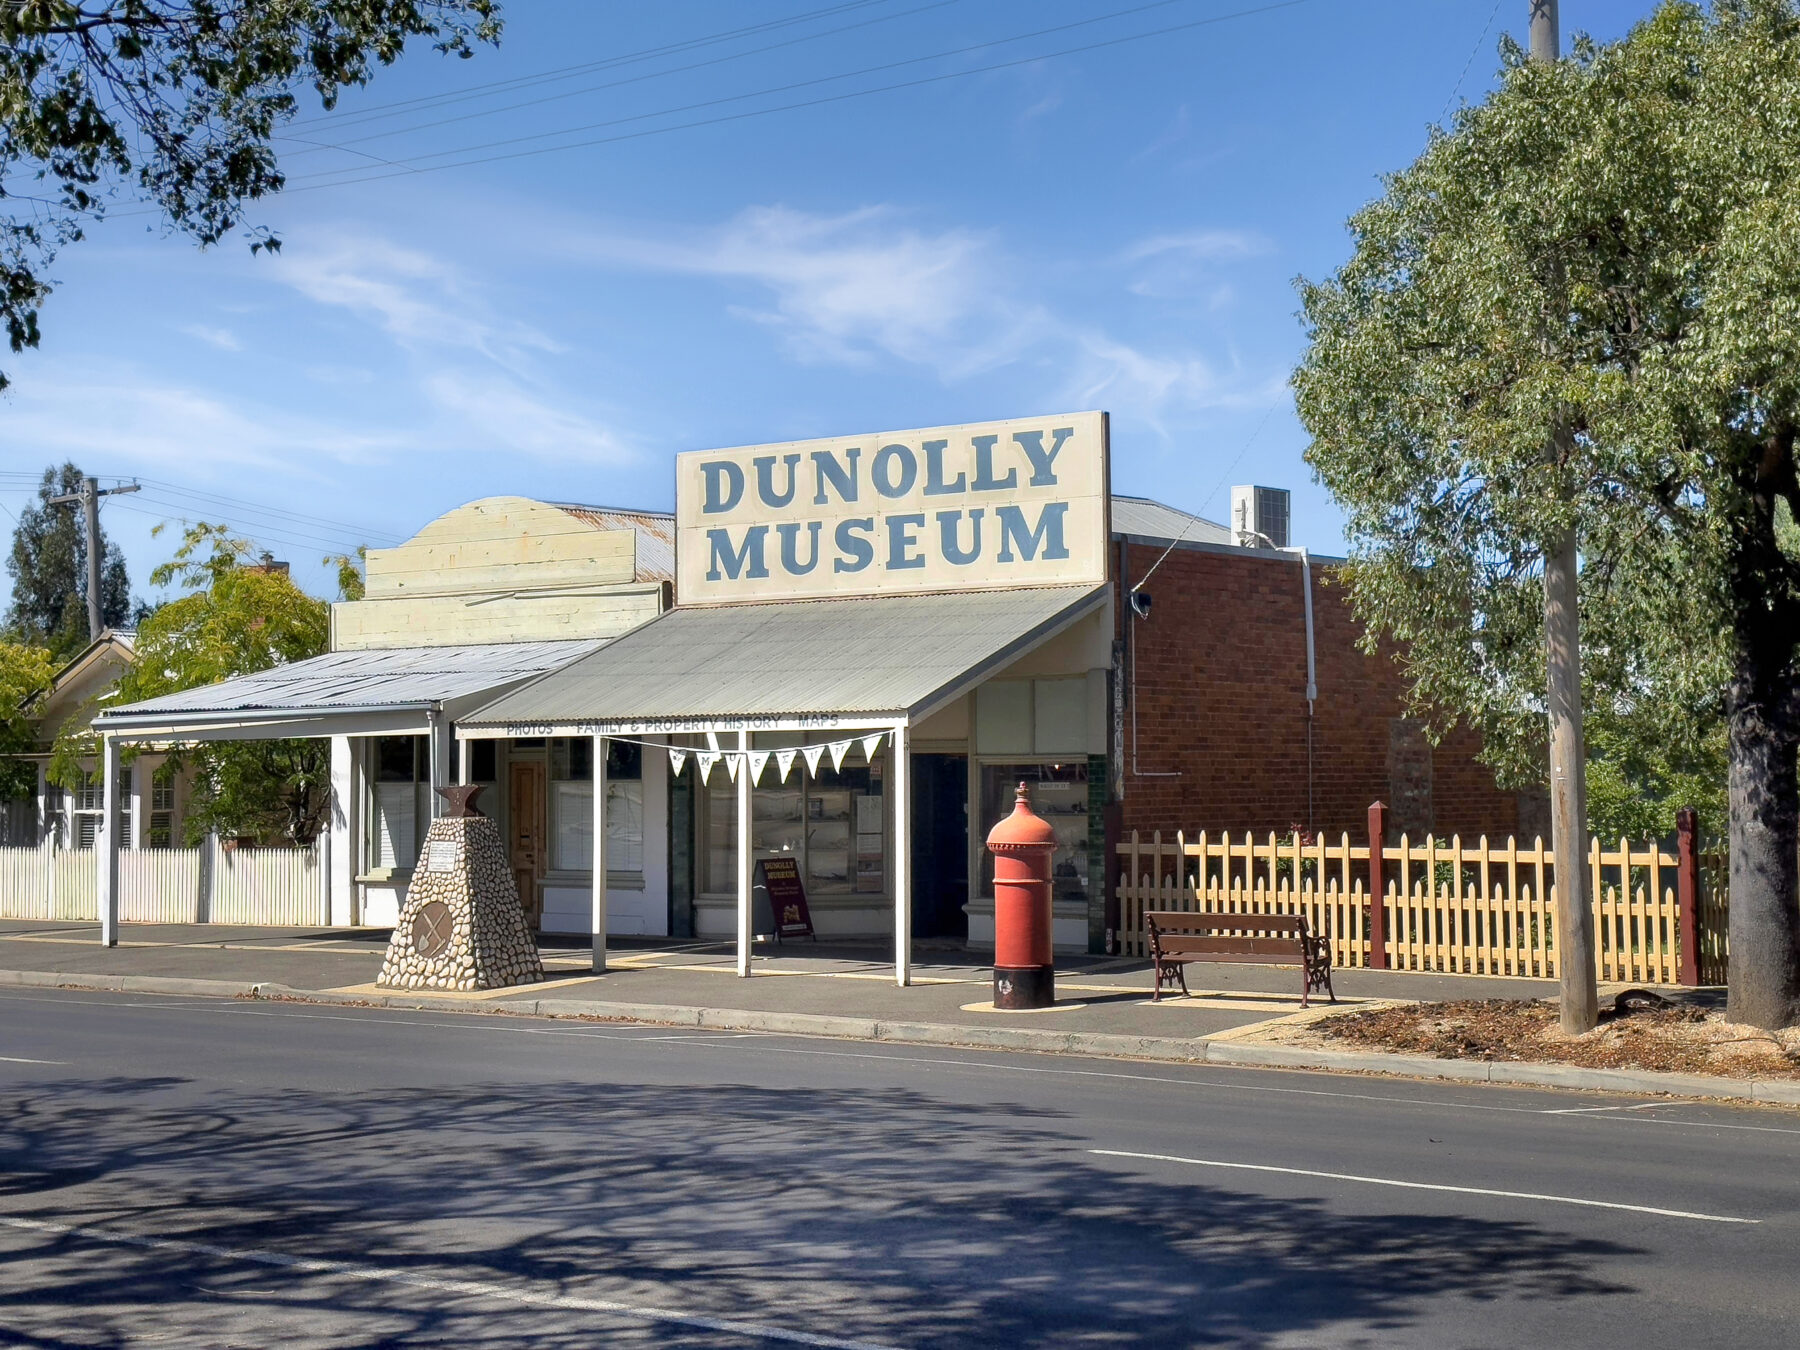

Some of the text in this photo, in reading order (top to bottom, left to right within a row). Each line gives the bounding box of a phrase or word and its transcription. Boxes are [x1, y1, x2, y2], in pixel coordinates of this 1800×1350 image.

[700, 427, 1074, 514] DUNOLLY
[705, 502, 1070, 581] MUSEUM
[507, 713, 839, 736] PHOTOS FAMILY & PROPERTY HISTORY MAPS
